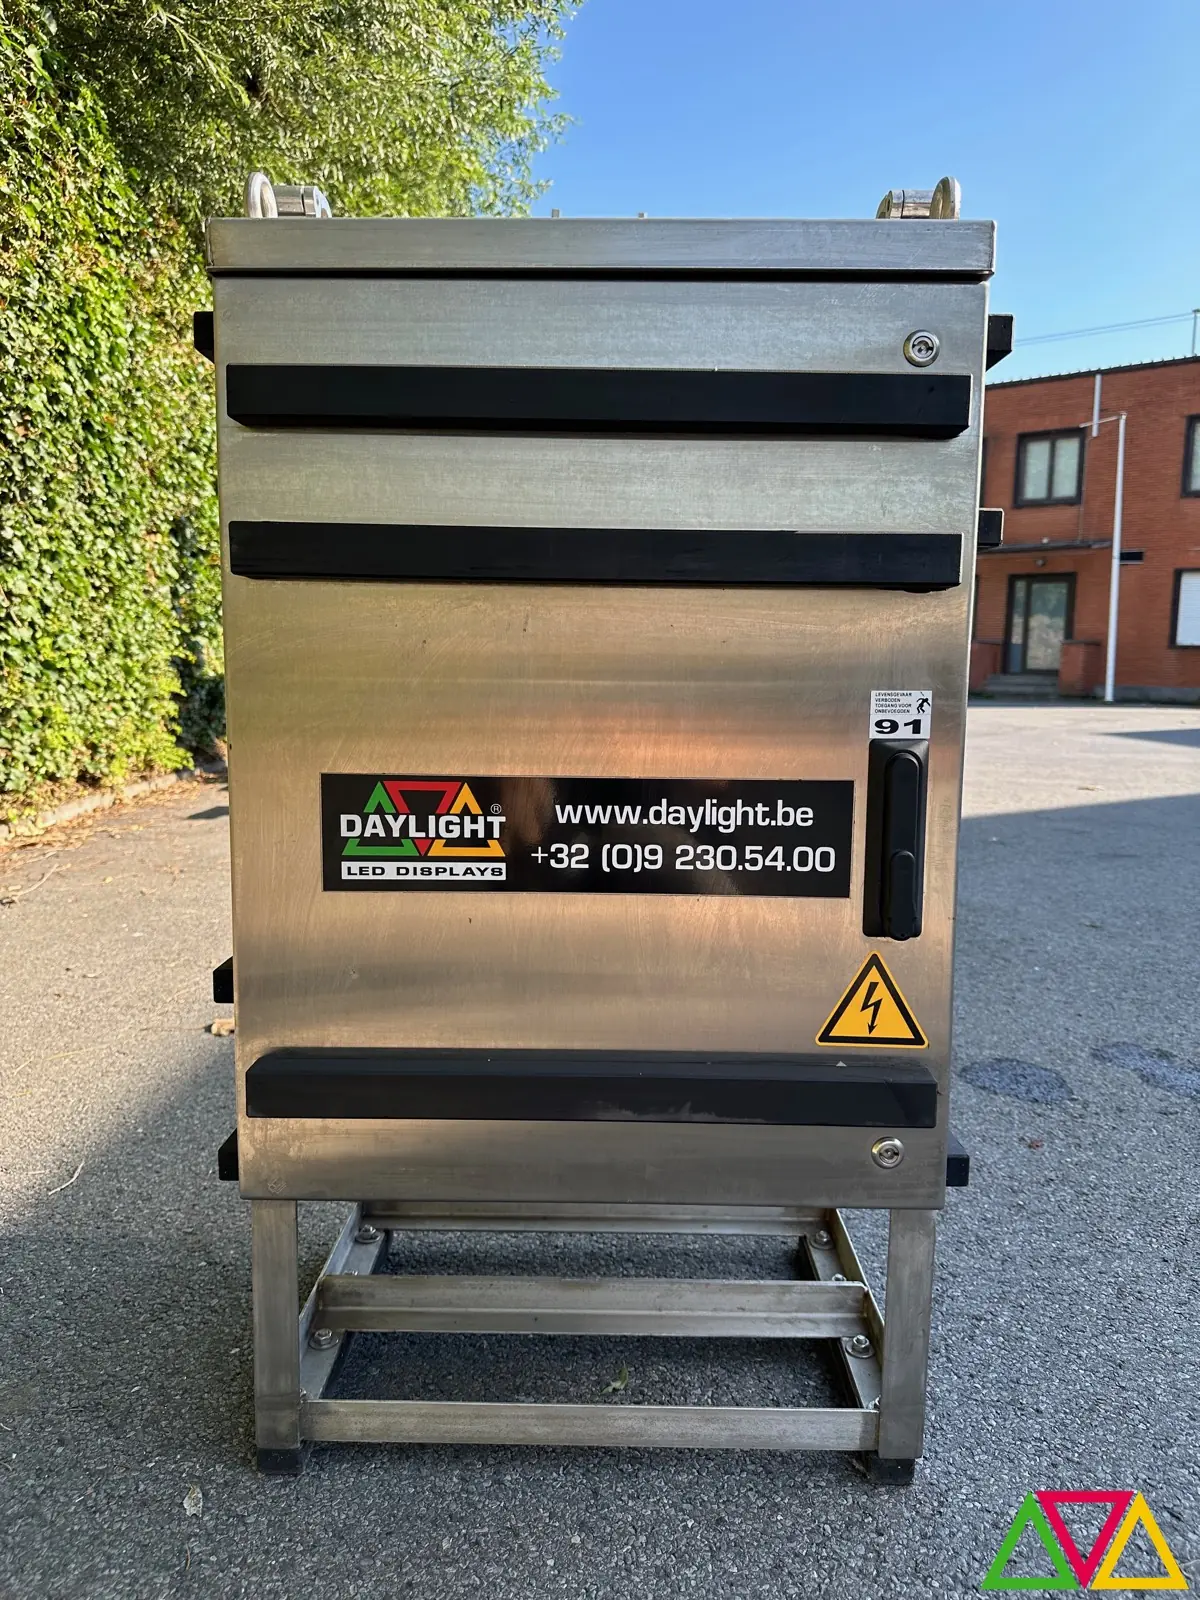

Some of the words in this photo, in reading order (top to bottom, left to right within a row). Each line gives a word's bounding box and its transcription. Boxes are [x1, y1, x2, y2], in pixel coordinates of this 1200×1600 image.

[874, 718, 922, 735] 91
[340, 813, 506, 839] DAYLIGHT
[555, 798, 814, 833] www.daylight.be
[530, 844, 590, 869] +32
[601, 843, 663, 873] (0)9
[674, 845, 836, 873] 230.54.00
[346, 866, 386, 877] LED
[396, 866, 504, 878] DISPLAYS
